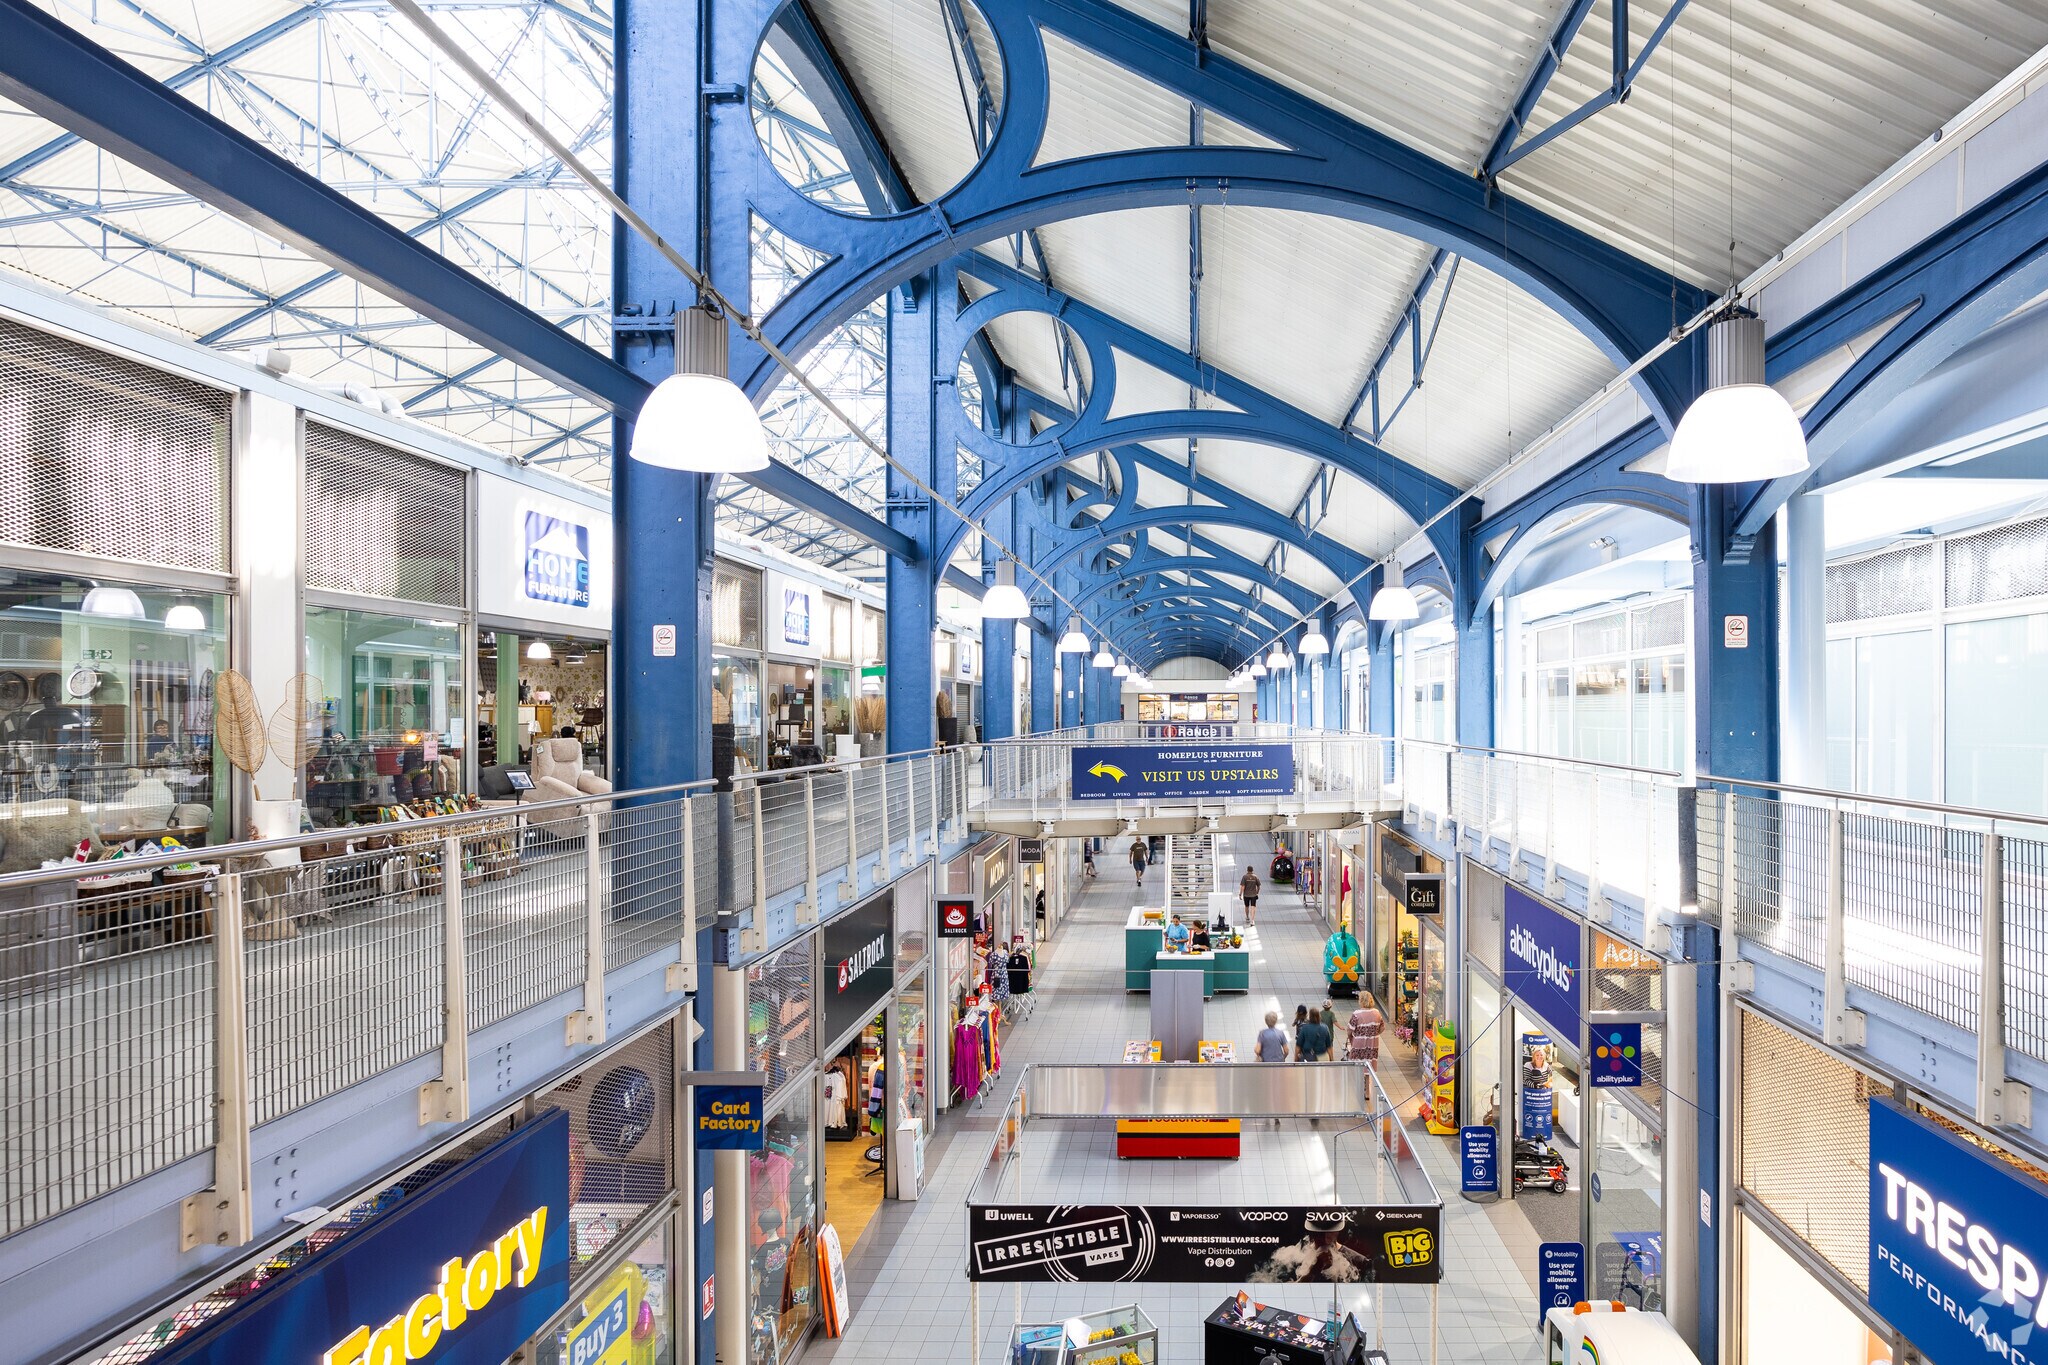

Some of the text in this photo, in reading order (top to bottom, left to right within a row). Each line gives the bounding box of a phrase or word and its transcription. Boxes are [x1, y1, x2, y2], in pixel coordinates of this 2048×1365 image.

[528, 550, 588, 584] HOME
[528, 581, 589, 602] FURNITURE
[1158, 751, 1208, 759] HOMEPLUS
[1142, 769, 1279, 782] VISIT US UPSTAIRS
[989, 858, 1005, 888] MODA
[1411, 890, 1436, 903] Gift
[848, 934, 885, 984] SALTROCK
[1510, 924, 1570, 992] abilityplus
[1596, 1075, 1634, 1084] abilityplus
[711, 1101, 750, 1115] Card
[699, 1116, 761, 1133] Factory
[1000, 1213, 1034, 1221] UWELL
[1240, 1211, 1289, 1221] VOOPOO
[1306, 1211, 1354, 1222] SMOK
[986, 1225, 1121, 1263] IRRESISTIBLE
[1161, 1236, 1280, 1244] WWW.IRRESISTIBLEVAPES.COM
[1390, 1233, 1431, 1254] BIG
[1089, 1250, 1120, 1262] VAPES
[1187, 1246, 1252, 1256] Vape Distribution
[1561, 1263, 1575, 1272] your
[1878, 1243, 2036, 1365] PERFORMANC
[574, 1299, 623, 1365] Buy 3
